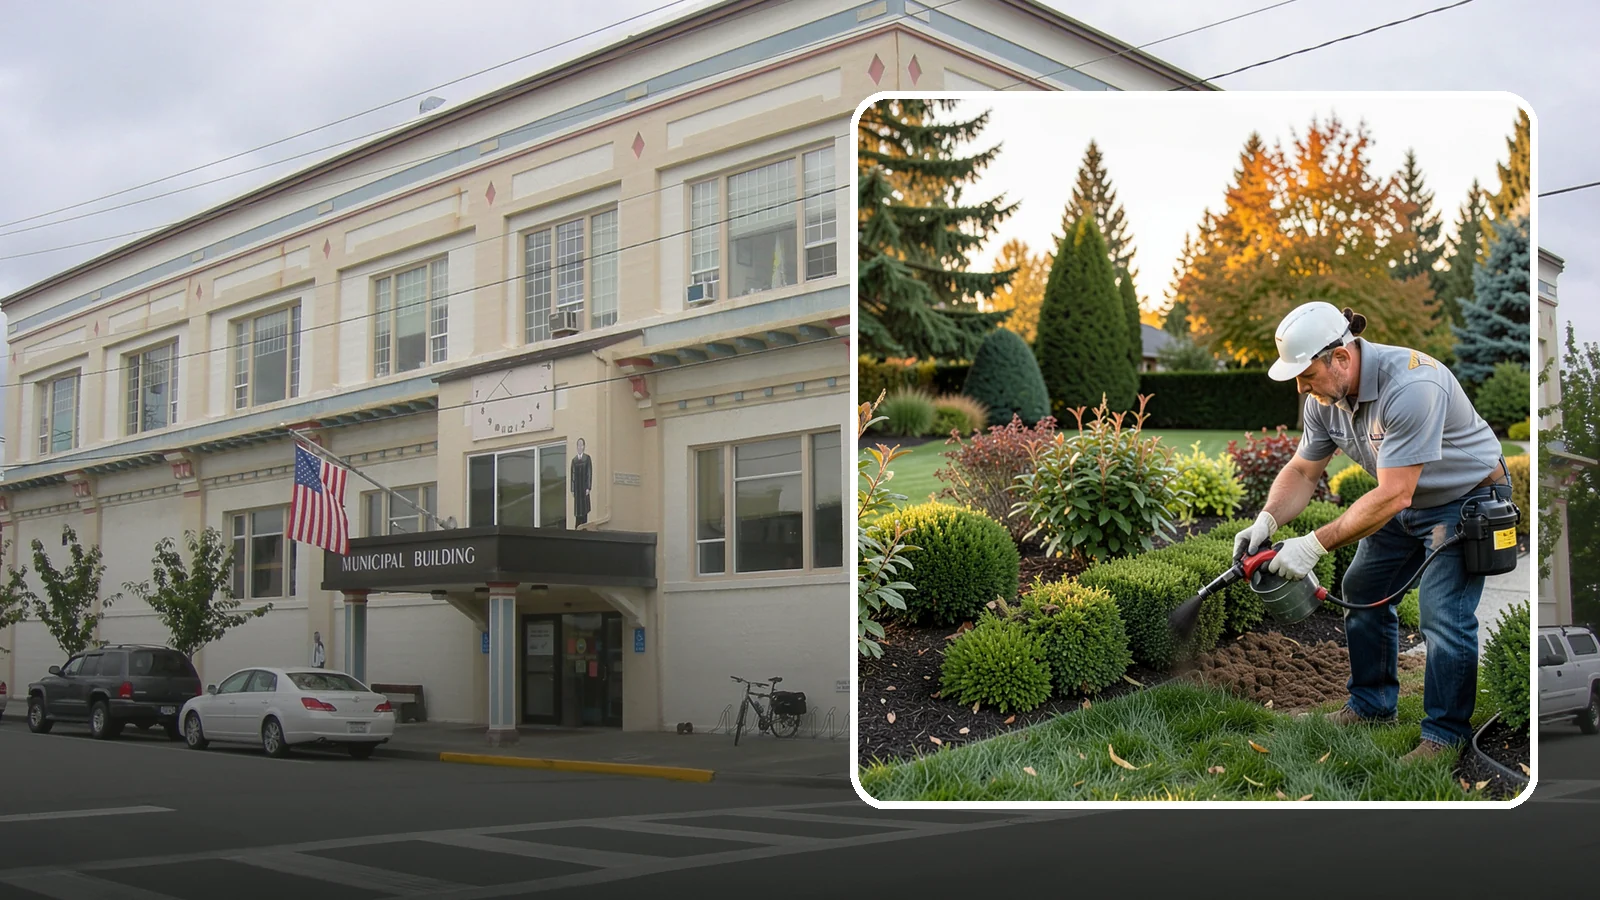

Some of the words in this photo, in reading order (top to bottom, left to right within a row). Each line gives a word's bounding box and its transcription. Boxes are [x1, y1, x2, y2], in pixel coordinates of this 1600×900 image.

[475, 389, 479, 398] 7
[536, 402, 540, 410] 4
[480, 407, 485, 415] 8
[487, 417, 492, 426] 9
[529, 414, 533, 422] 3
[494, 423, 500, 432] 10
[507, 425, 513, 433] 12
[521, 420, 526, 428] 2
[342, 552, 405, 572] MUNICIPAL
[414, 546, 475, 567] BUILDING
